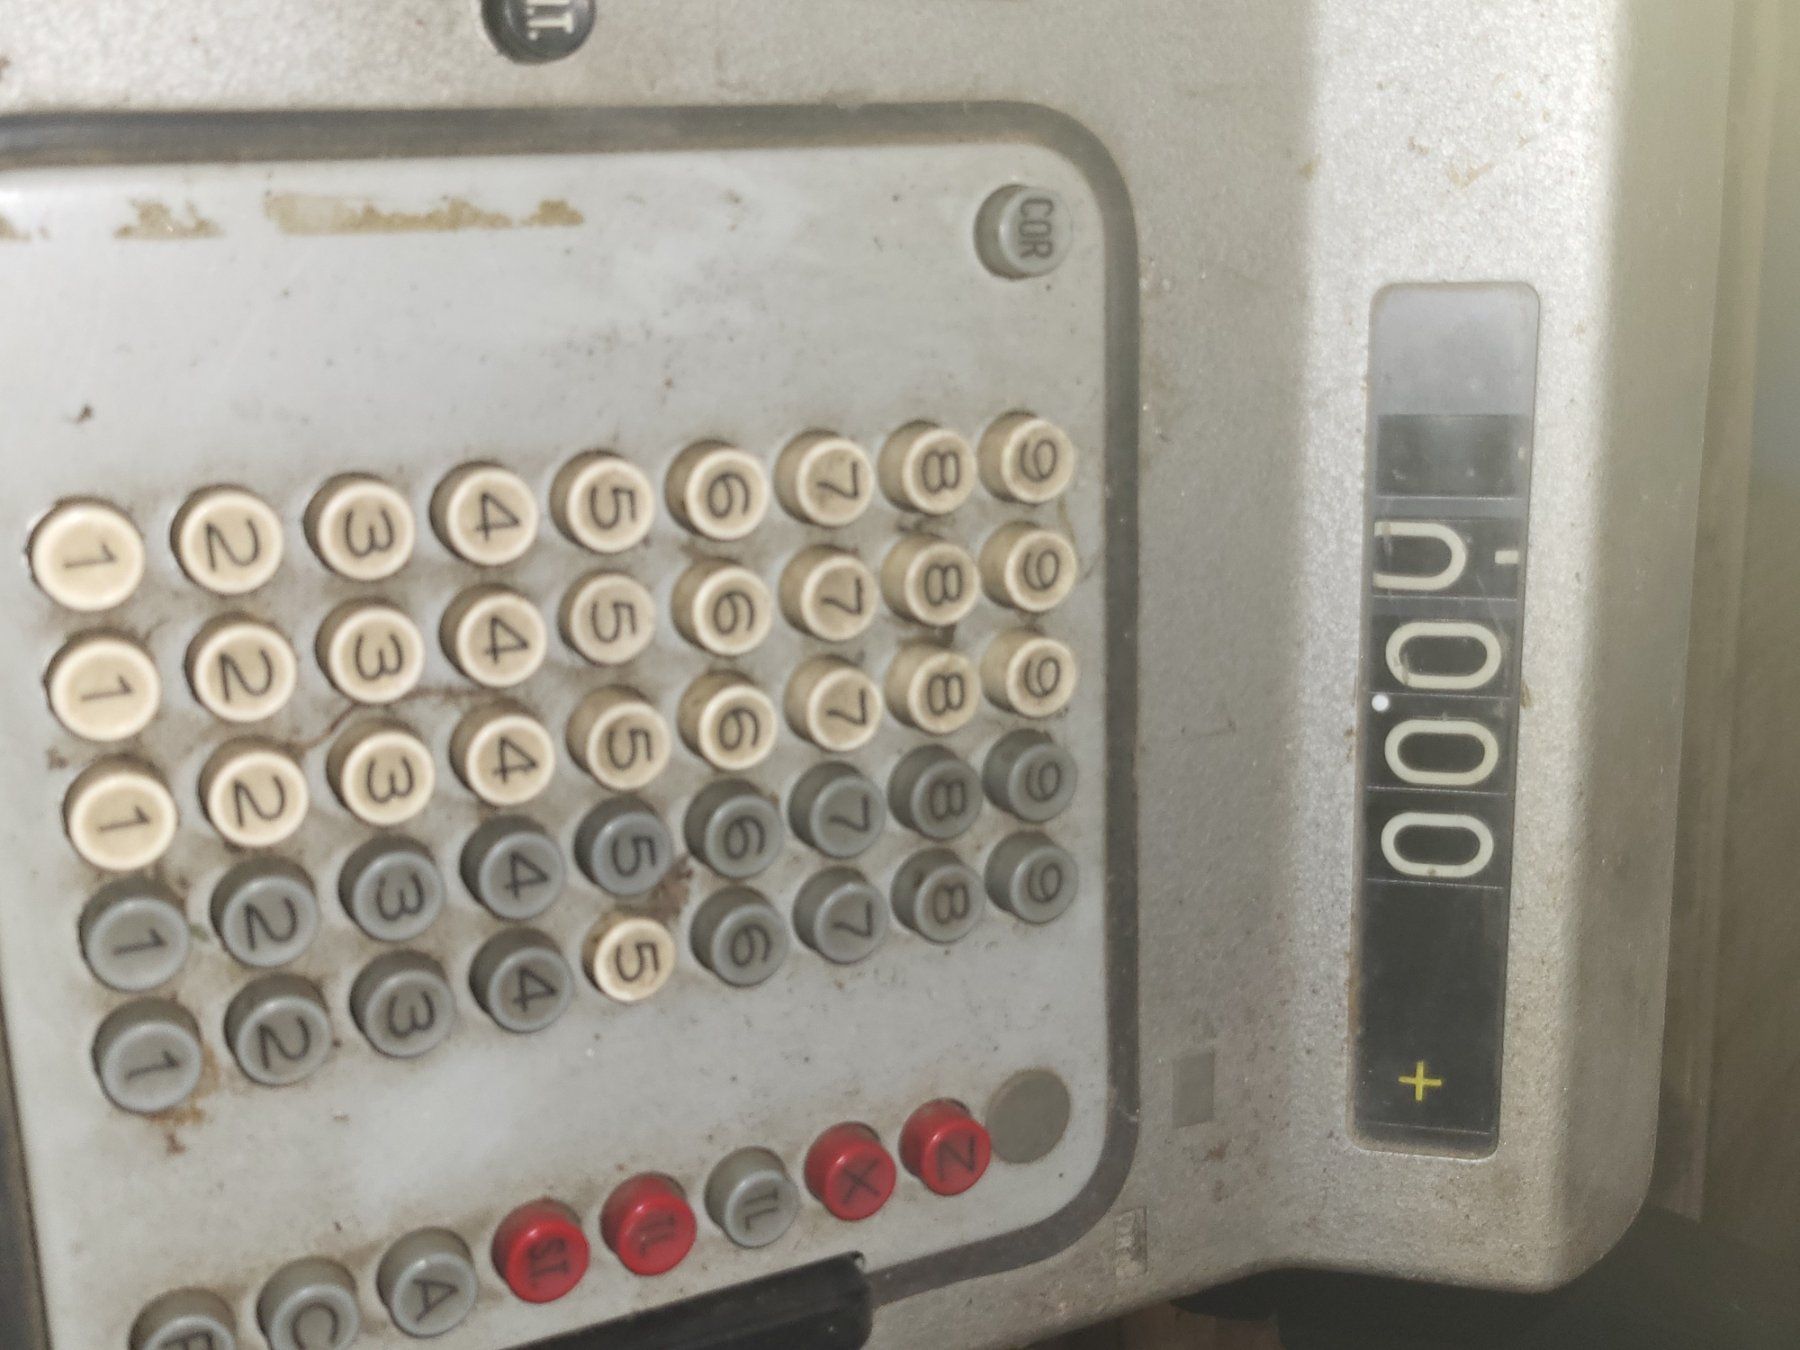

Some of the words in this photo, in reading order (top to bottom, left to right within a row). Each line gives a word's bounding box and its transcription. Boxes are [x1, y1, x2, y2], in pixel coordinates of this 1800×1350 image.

[1019, 198, 1055, 259] COR
[817, 462, 861, 499] 7
[921, 450, 961, 495] 8
[1019, 439, 1058, 483] 9
[475, 491, 522, 542] 4
[589, 486, 636, 531] 5
[705, 472, 752, 519] 6
[206, 518, 261, 571] 2
[344, 508, 395, 557] 3
[64, 543, 119, 569] 1
[1023, 550, 1060, 592] 9
[823, 578, 865, 616] 7
[923, 564, 964, 606] 8
[591, 603, 636, 643] 5
[713, 592, 755, 635] 6
[354, 634, 402, 682] 3
[486, 617, 529, 665] 4
[80, 675, 133, 702] 1
[219, 648, 274, 702] 2
[927, 673, 966, 715] 8
[1024, 657, 1061, 698] 9
[718, 707, 760, 749] 6
[826, 689, 868, 726] 7
[493, 737, 539, 783] 4
[606, 727, 653, 771] 5
[367, 756, 415, 803] 3
[929, 779, 968, 821] 8
[1025, 761, 1062, 802] 9
[97, 807, 150, 832] 1
[232, 777, 285, 827] 2
[830, 797, 871, 832] 7
[611, 835, 658, 876] 5
[725, 817, 767, 860] 6
[506, 851, 549, 897] 4
[1026, 862, 1063, 902] 9
[377, 873, 424, 921] 3
[933, 885, 970, 924] 8
[244, 898, 297, 950] 2
[834, 902, 875, 937] 7
[113, 928, 167, 956] 1
[616, 942, 660, 982] 5
[731, 924, 771, 967] 6
[515, 968, 559, 1012] 4
[388, 991, 436, 1037] 3
[257, 1017, 311, 1069] 2
[127, 1051, 180, 1080] 1
[935, 1135, 979, 1181] Z
[840, 1156, 880, 1206] X
[412, 1277, 459, 1324] A
[290, 1300, 339, 1350] C
